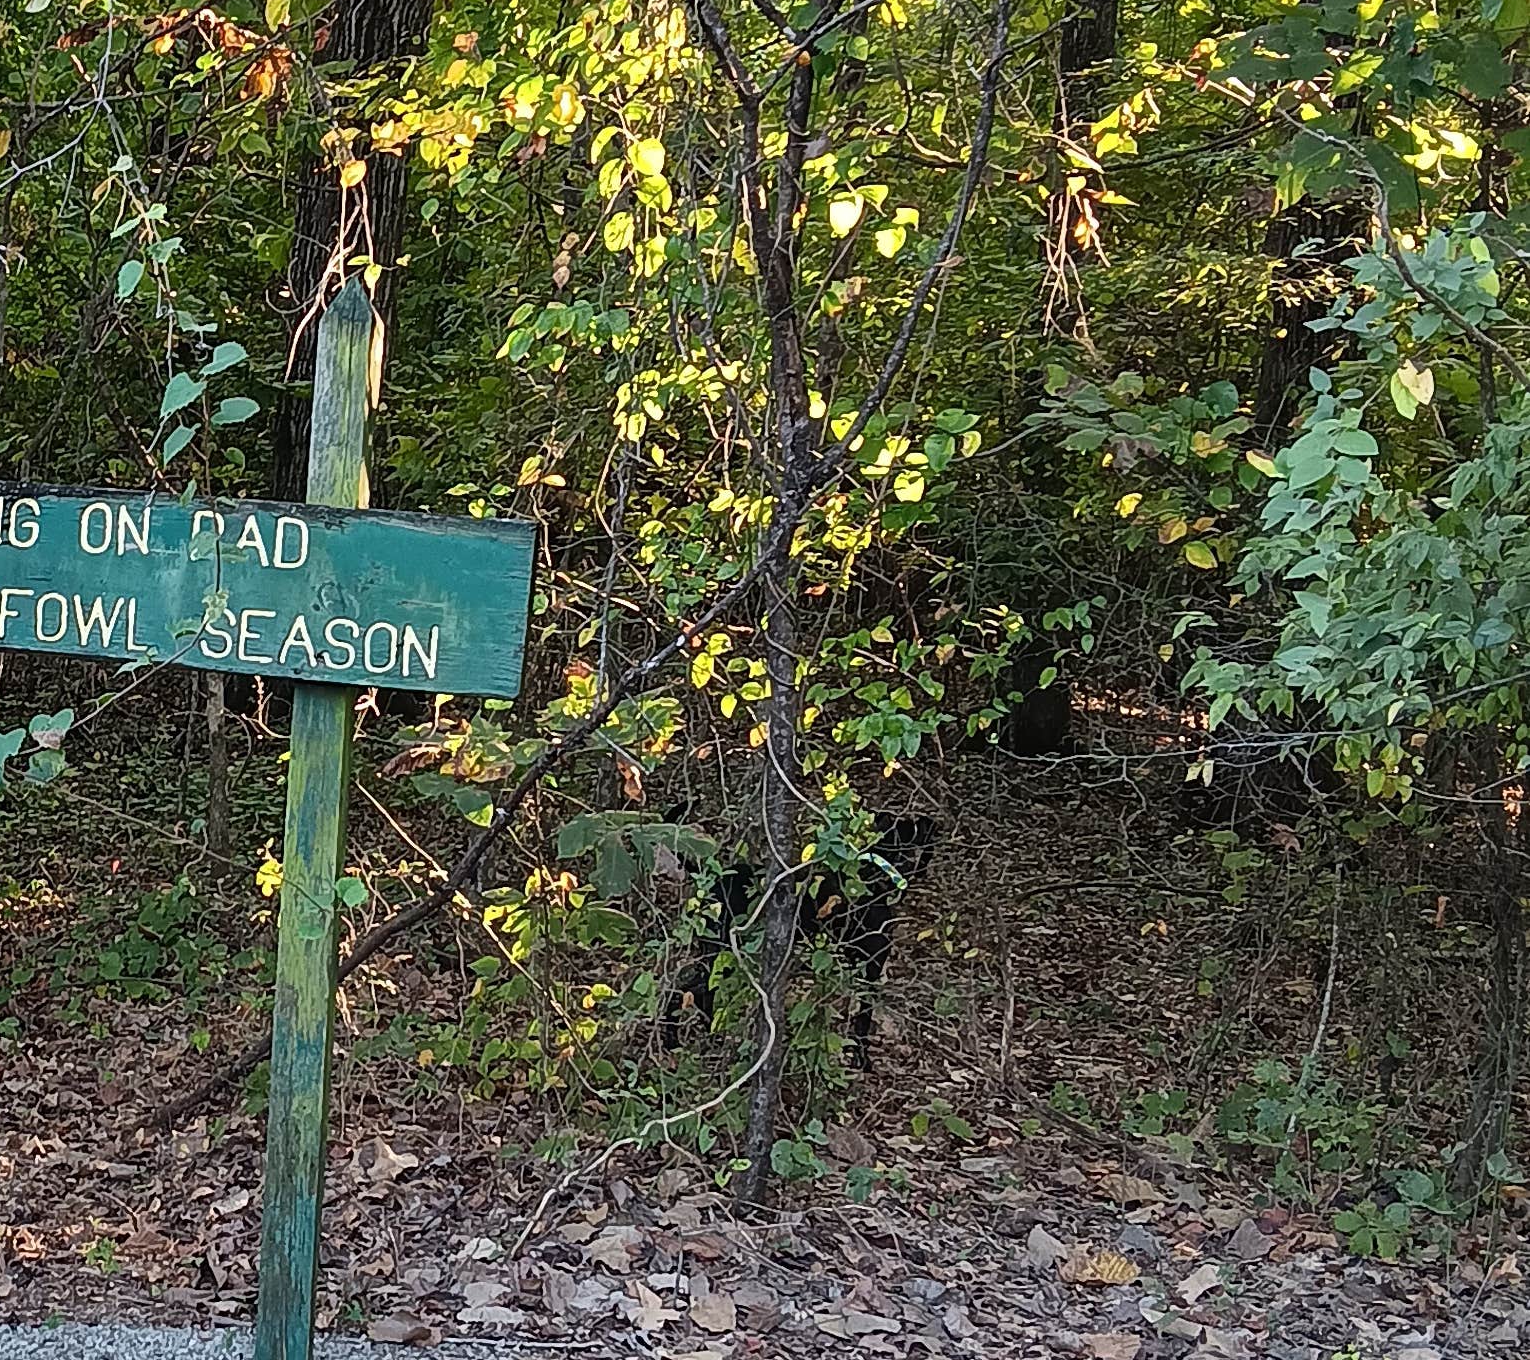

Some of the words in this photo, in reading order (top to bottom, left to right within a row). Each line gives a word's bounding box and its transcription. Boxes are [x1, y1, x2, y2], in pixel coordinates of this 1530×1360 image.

[80, 502, 152, 556] ON
[189, 509, 309, 570] PAD
[199, 608, 440, 680] SEASON
